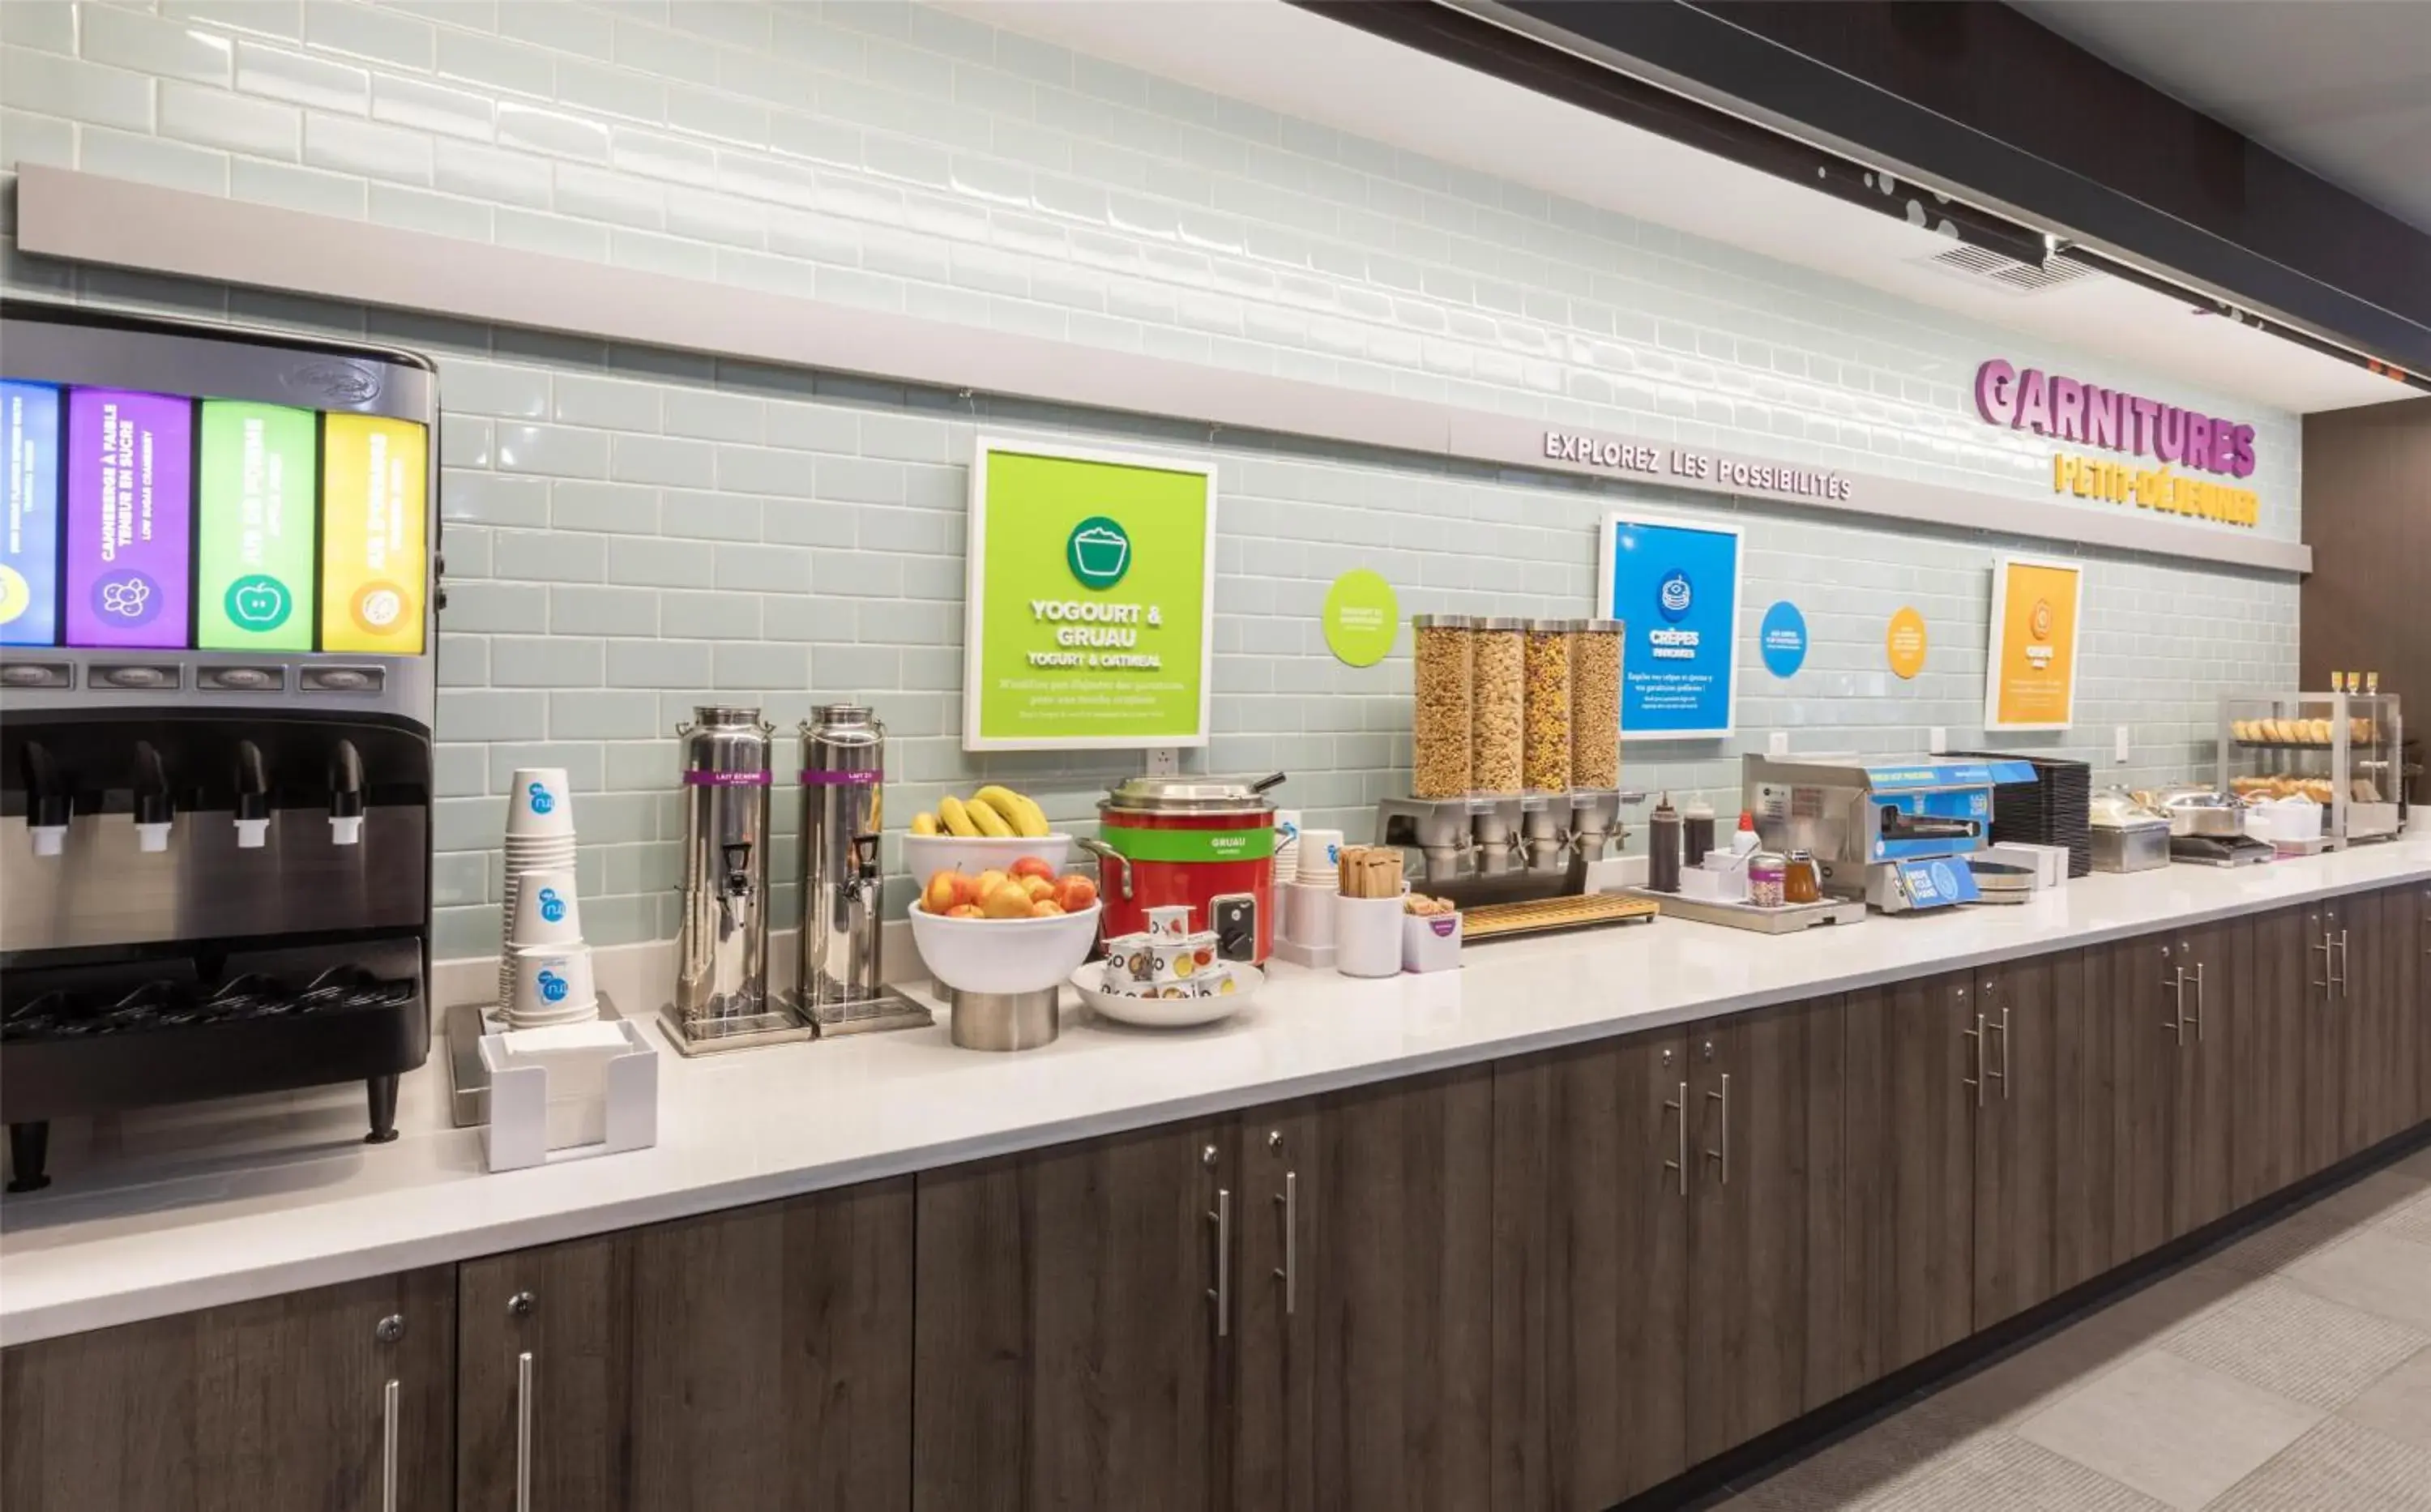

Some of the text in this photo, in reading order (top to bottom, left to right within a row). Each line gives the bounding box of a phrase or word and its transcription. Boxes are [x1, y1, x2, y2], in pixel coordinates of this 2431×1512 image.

[1975, 359, 2255, 480] GARNITURES
[119, 420, 135, 468] SUCRE
[1544, 431, 1852, 501] EXPLOREZ LES POSSIBILITÉS
[1031, 600, 1163, 625] YOGOURT &
[1057, 627, 1137, 648] GRUAU
[1027, 651, 1086, 667] YOGURT
[1211, 837, 1245, 848] GRUAU
